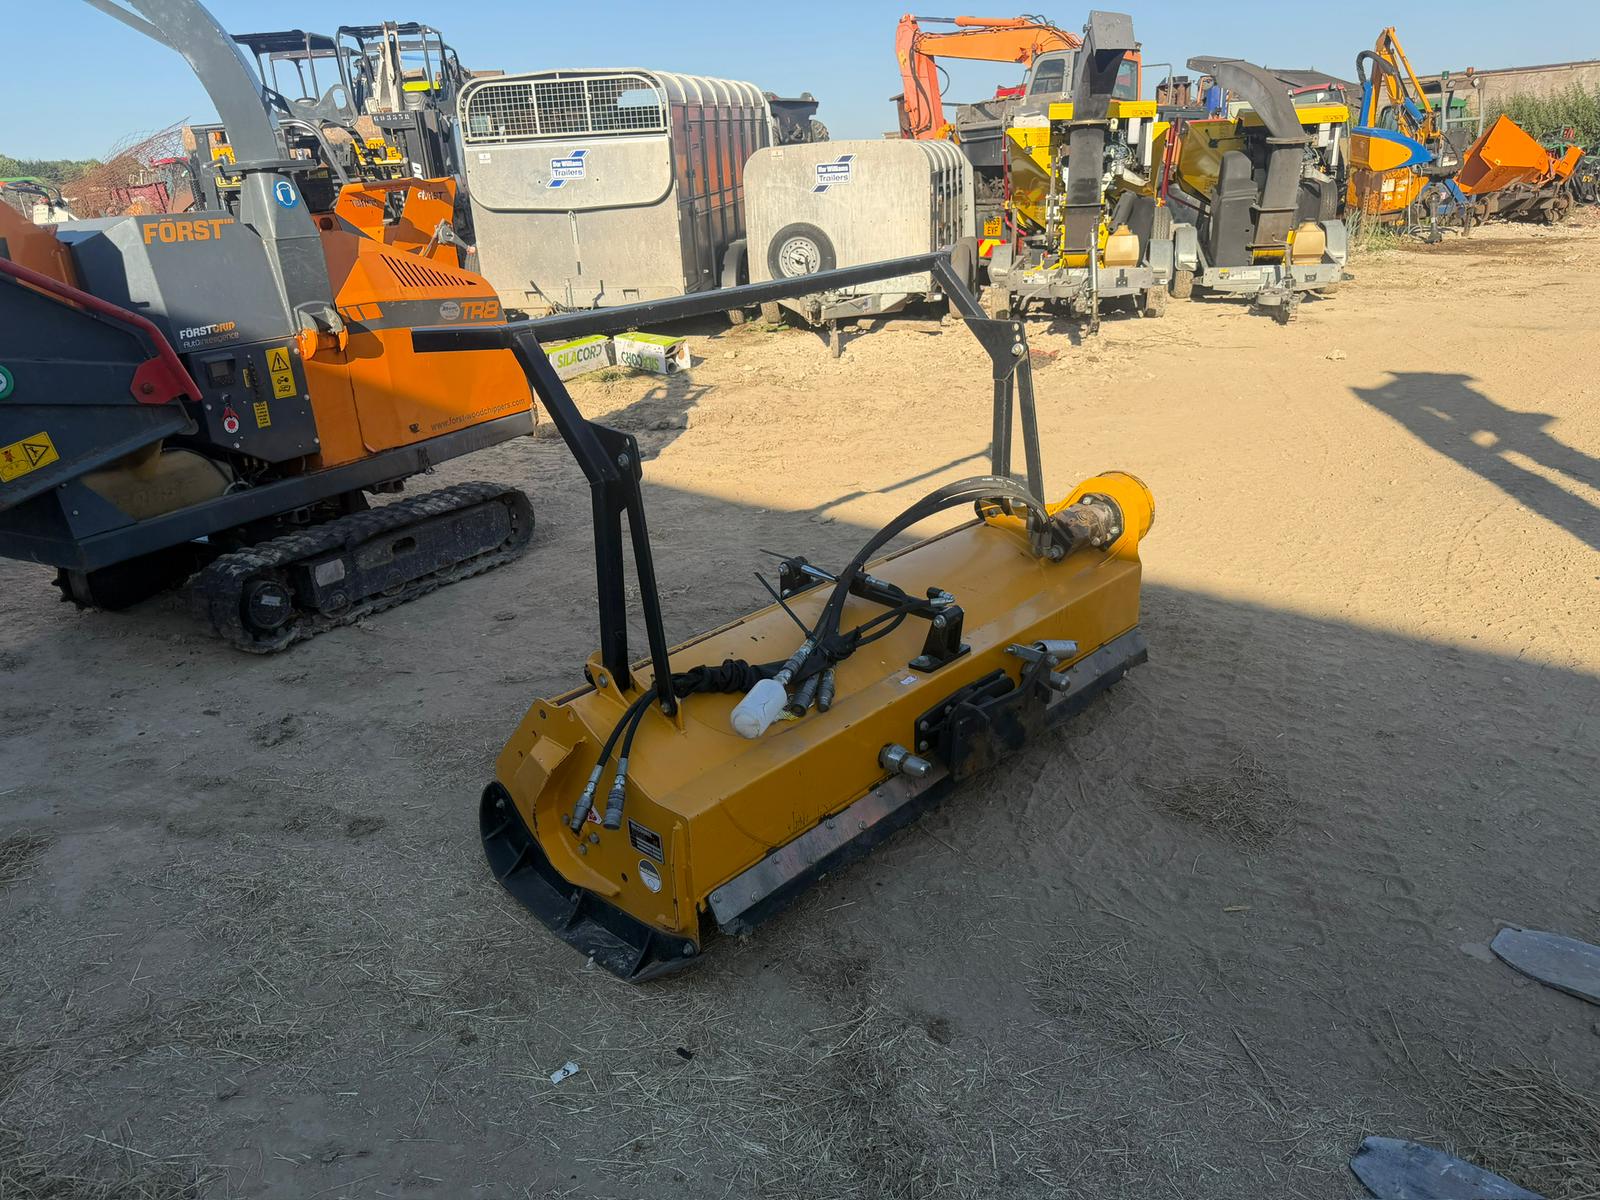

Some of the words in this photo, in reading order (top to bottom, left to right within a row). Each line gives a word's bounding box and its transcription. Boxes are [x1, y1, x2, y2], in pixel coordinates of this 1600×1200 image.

[554, 169, 583, 177] Trailers
[819, 174, 849, 182] Trailers
[143, 219, 222, 244] FÖRST
[460, 301, 499, 320] TR8
[557, 344, 603, 369] SILACORD
[431, 398, 525, 431] www.forst-woodchippers.com
